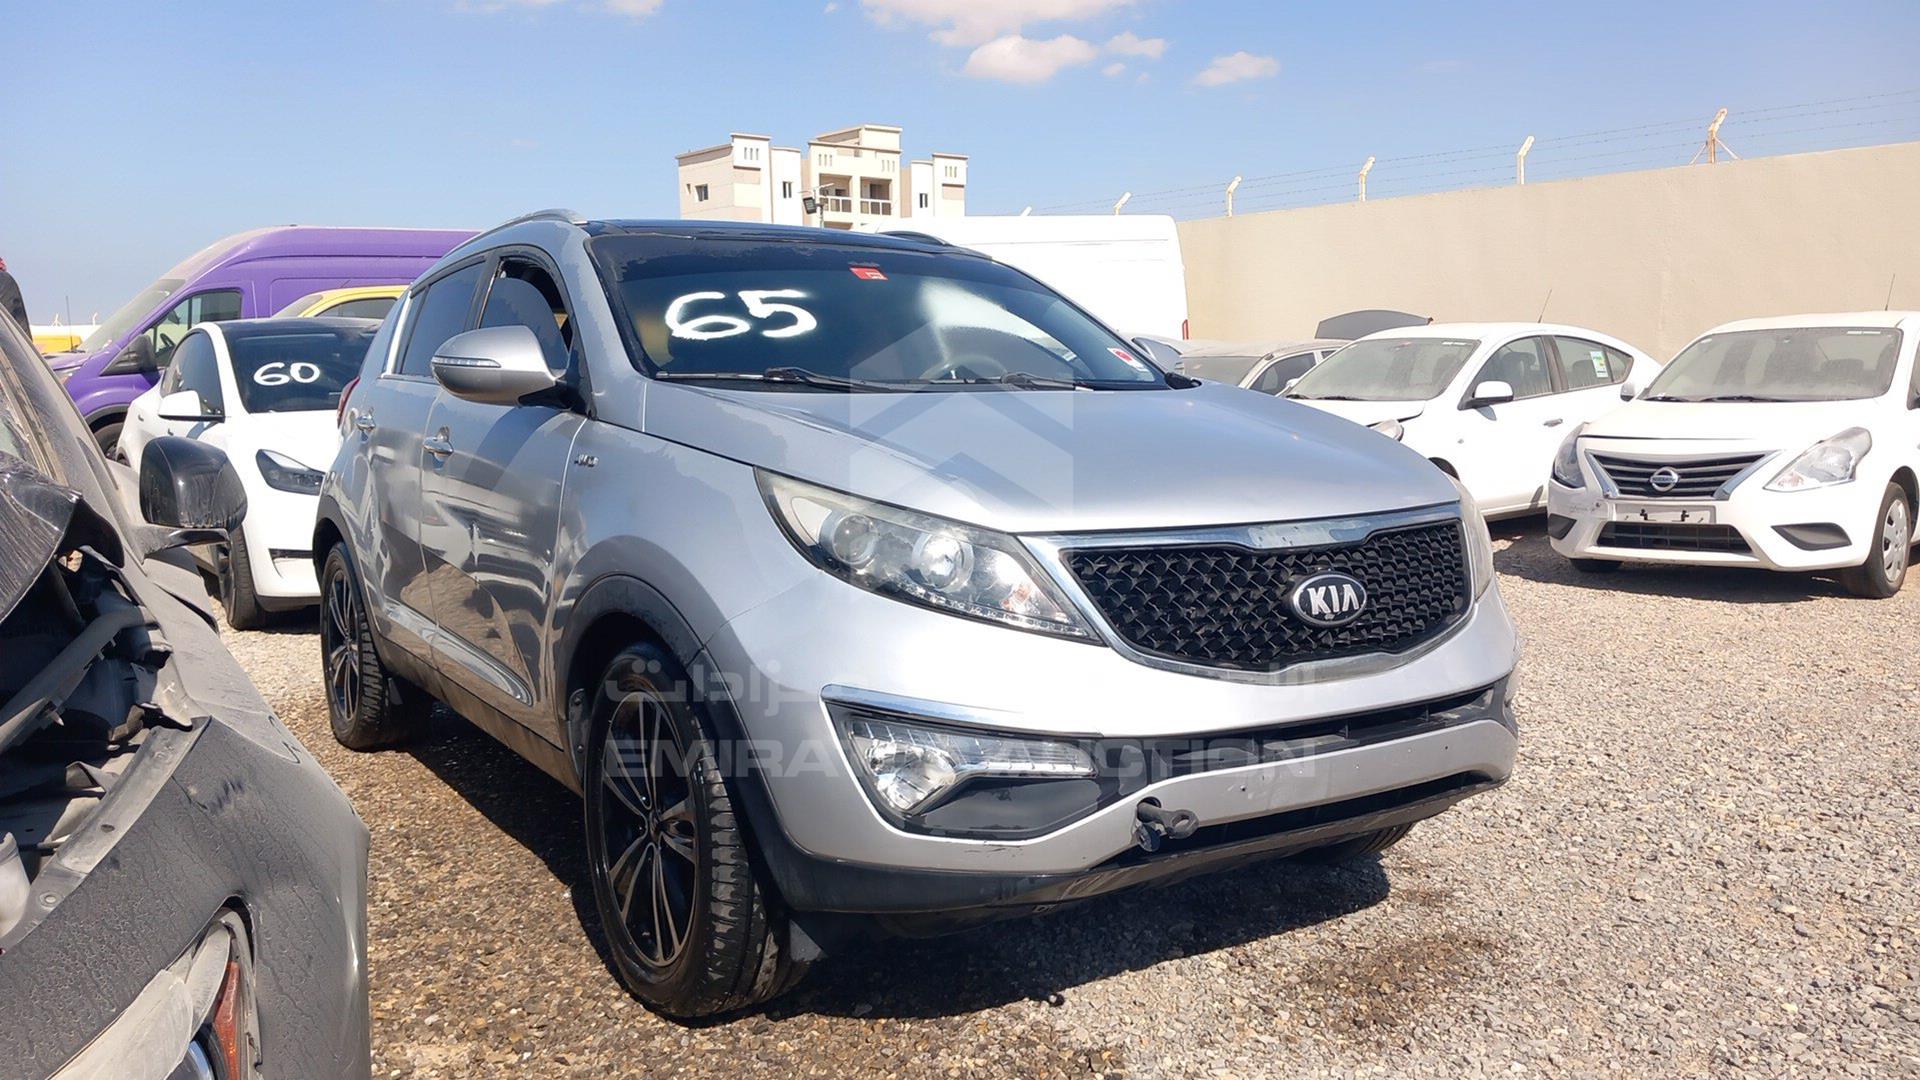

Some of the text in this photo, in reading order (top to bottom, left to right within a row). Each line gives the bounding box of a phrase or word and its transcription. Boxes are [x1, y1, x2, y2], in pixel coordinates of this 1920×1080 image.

[665, 289, 817, 341] 65
[253, 361, 320, 386] 60
[1307, 583, 1360, 616] KIA
